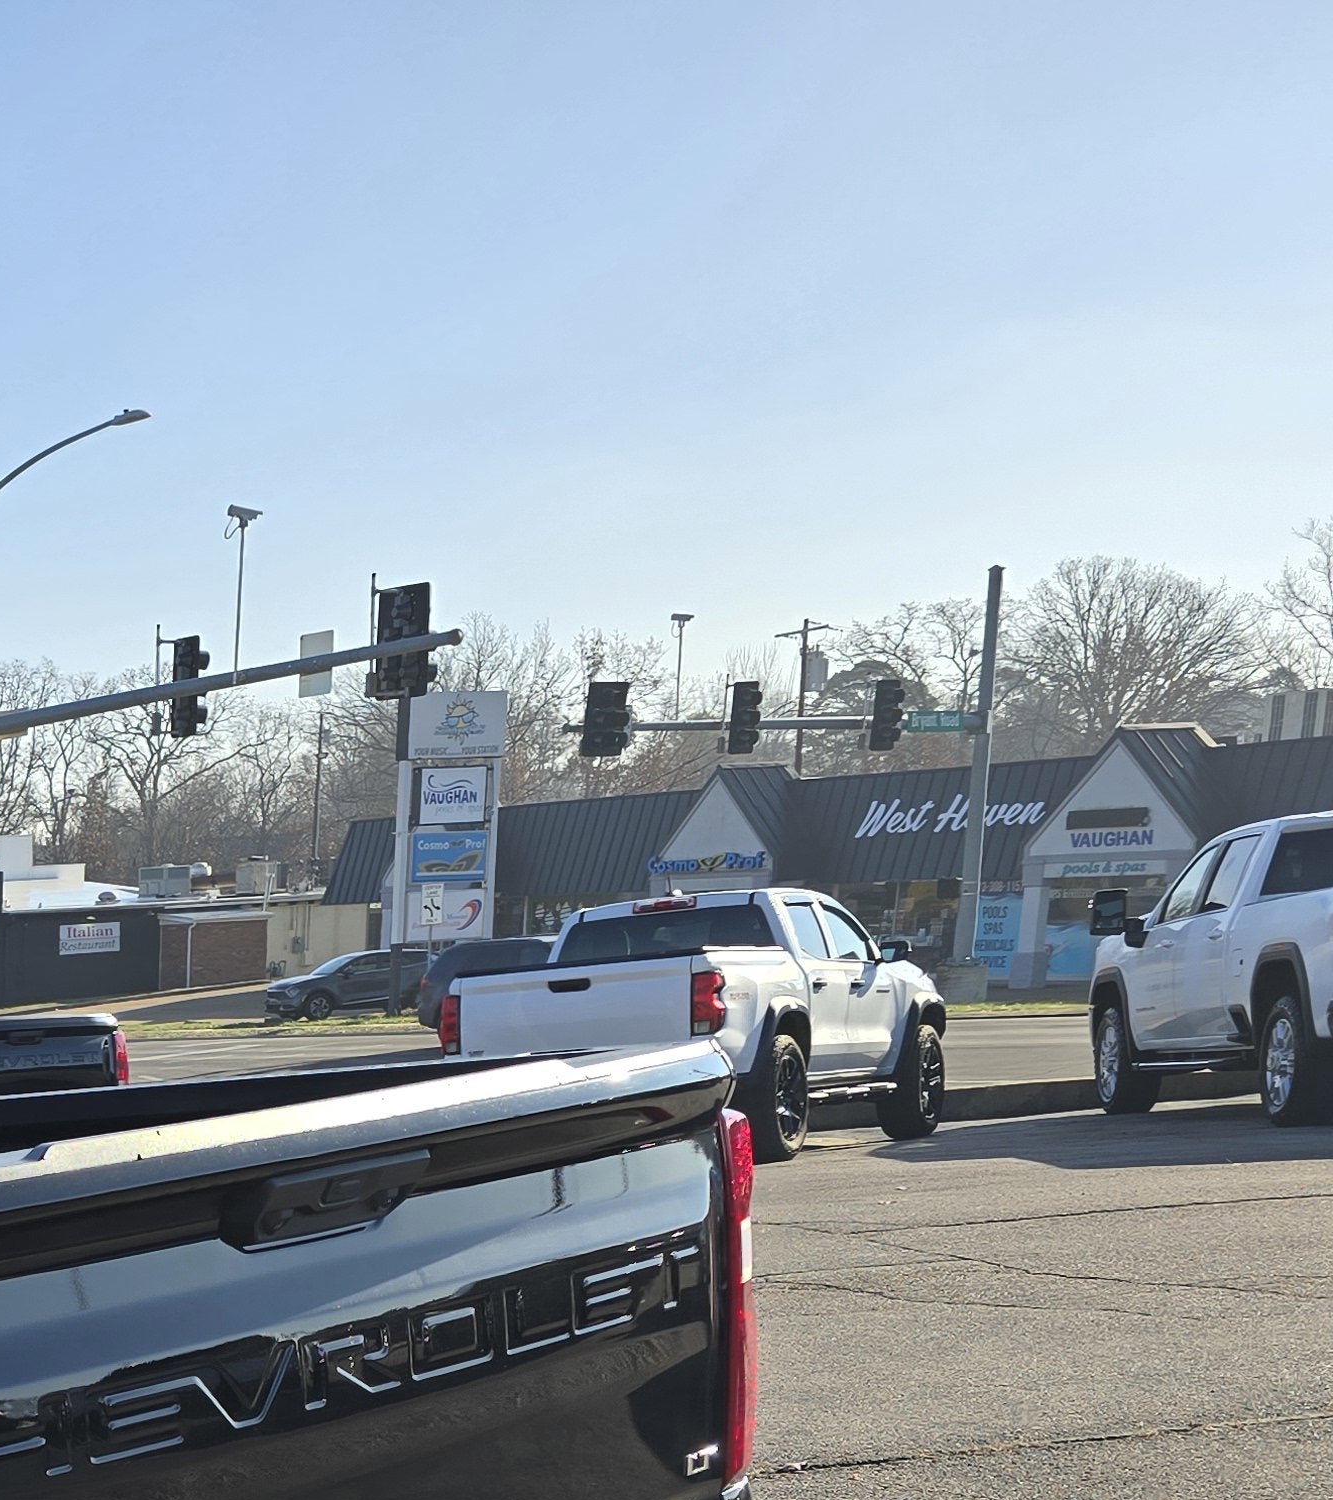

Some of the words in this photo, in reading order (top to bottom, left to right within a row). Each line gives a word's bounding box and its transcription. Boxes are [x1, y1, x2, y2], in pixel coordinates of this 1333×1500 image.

[423, 790, 478, 805] VAUGHAN
[854, 798, 935, 838] West
[933, 794, 1046, 833] Hven
[1070, 829, 1154, 848] VAUGHAN
[417, 840, 450, 851] Cosmo
[647, 857, 699, 875] Cosmo
[724, 850, 766, 869] Prof
[1061, 862, 1100, 878] pools
[1115, 862, 1147, 876] spas
[982, 906, 1008, 918] POOLS
[67, 926, 113, 938] Italian
[983, 922, 1004, 935] SPAS
[61, 940, 116, 951] Restaurant
[976, 939, 1014, 951] HEMICALS
